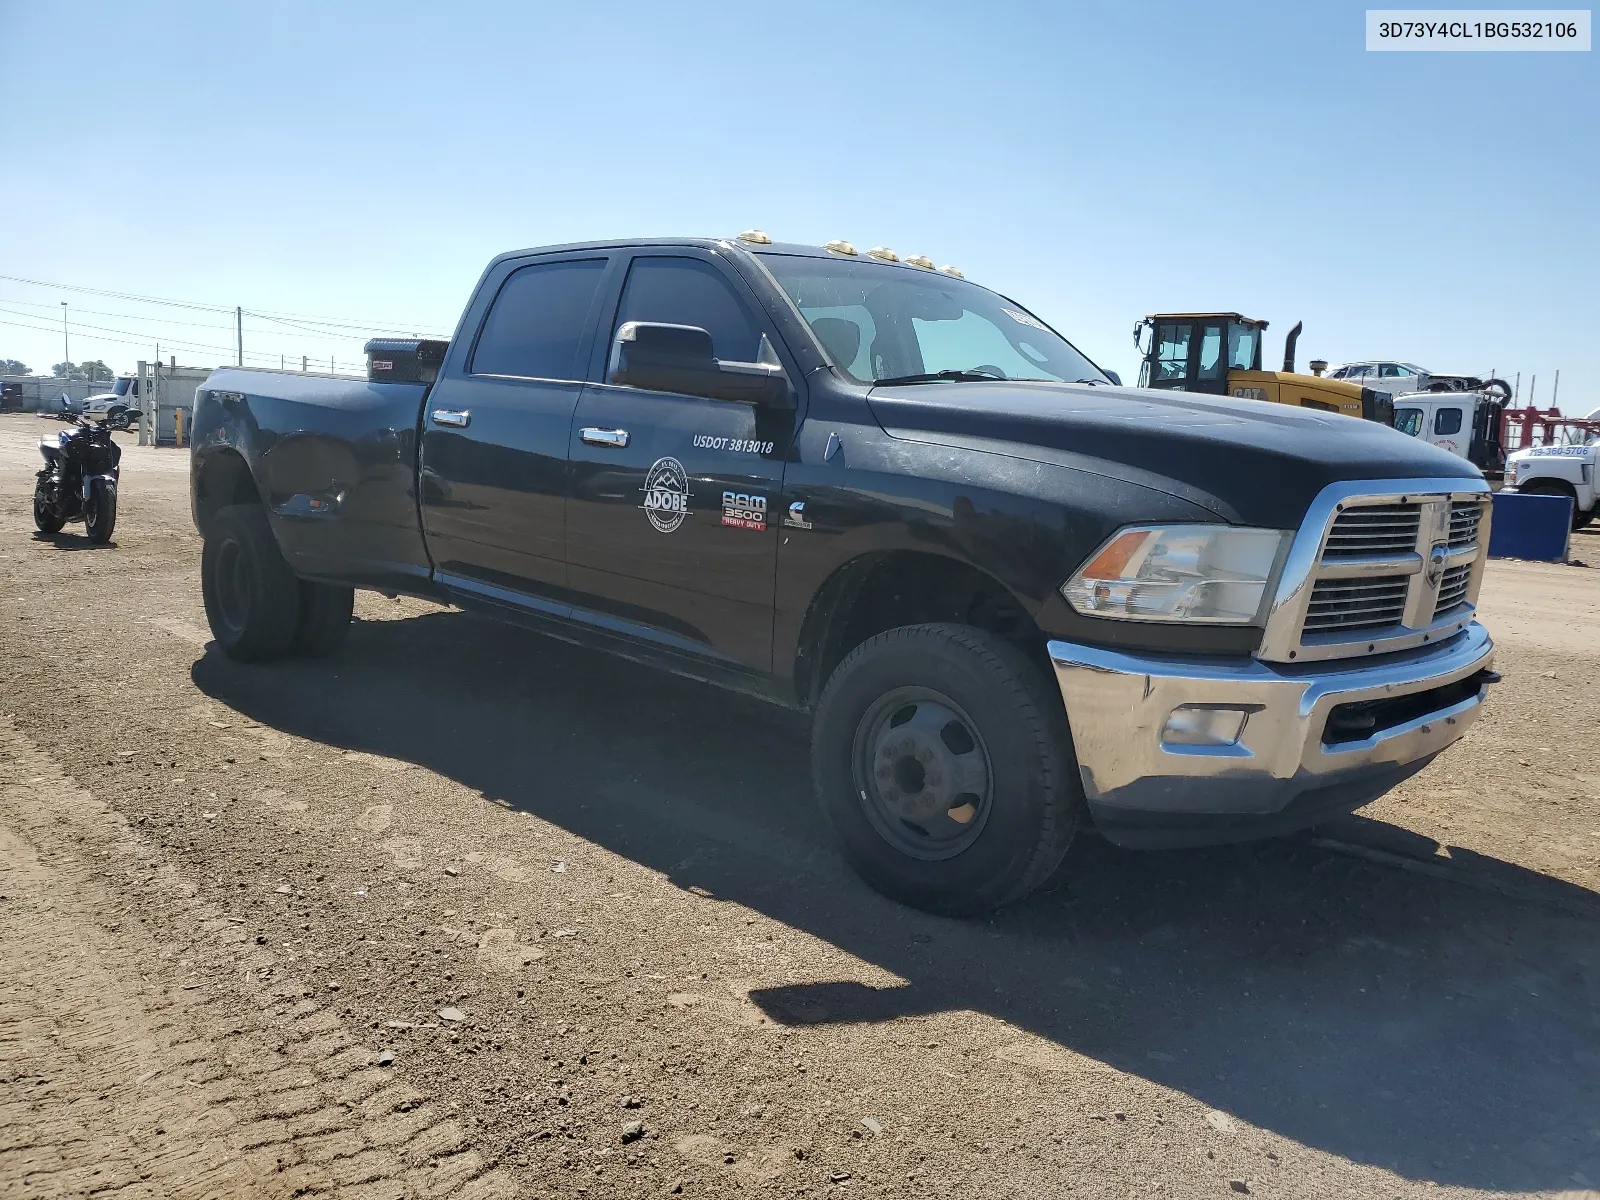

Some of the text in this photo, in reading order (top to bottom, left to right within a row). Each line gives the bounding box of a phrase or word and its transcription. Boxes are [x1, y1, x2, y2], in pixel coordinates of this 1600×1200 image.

[692, 434, 774, 454] USDOT 3813018
[1529, 447, 1590, 457] 719-360-5706
[643, 491, 688, 511] ADOBE
[724, 507, 762, 522] 3500
[725, 518, 761, 530] HEAVY DUTY
